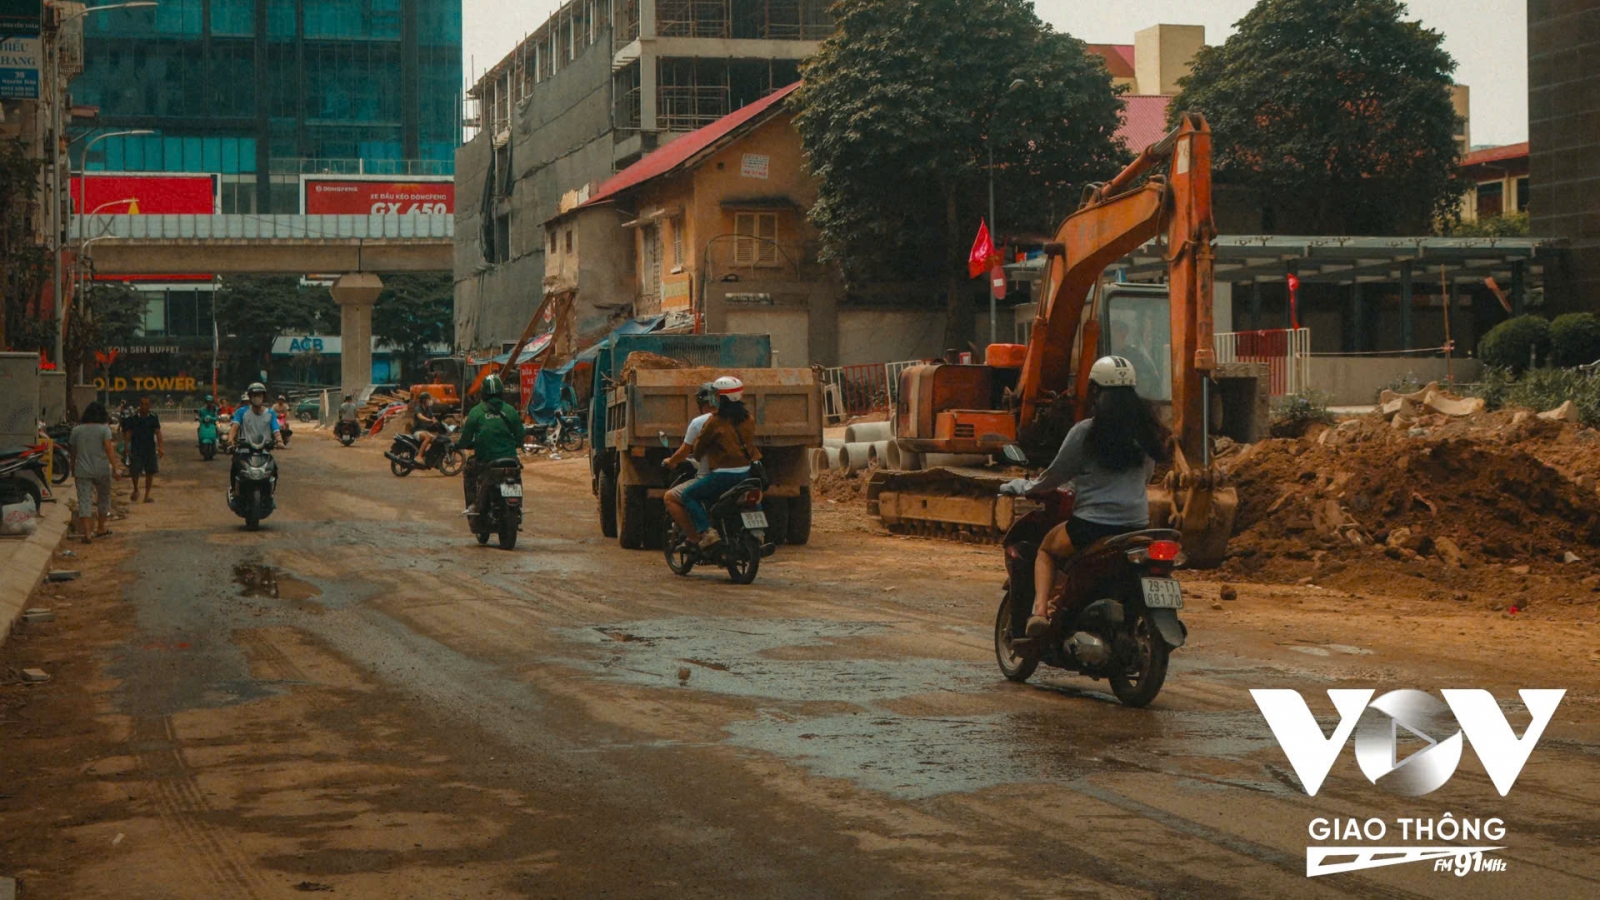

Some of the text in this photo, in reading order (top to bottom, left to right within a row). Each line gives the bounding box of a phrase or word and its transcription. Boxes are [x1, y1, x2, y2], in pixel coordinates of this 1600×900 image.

[0, 57, 35, 66] HANG
[130, 346, 147, 354] SEN
[149, 346, 180, 354] BUFFET
[289, 338, 324, 352] ACB
[132, 376, 196, 391] TOWER
